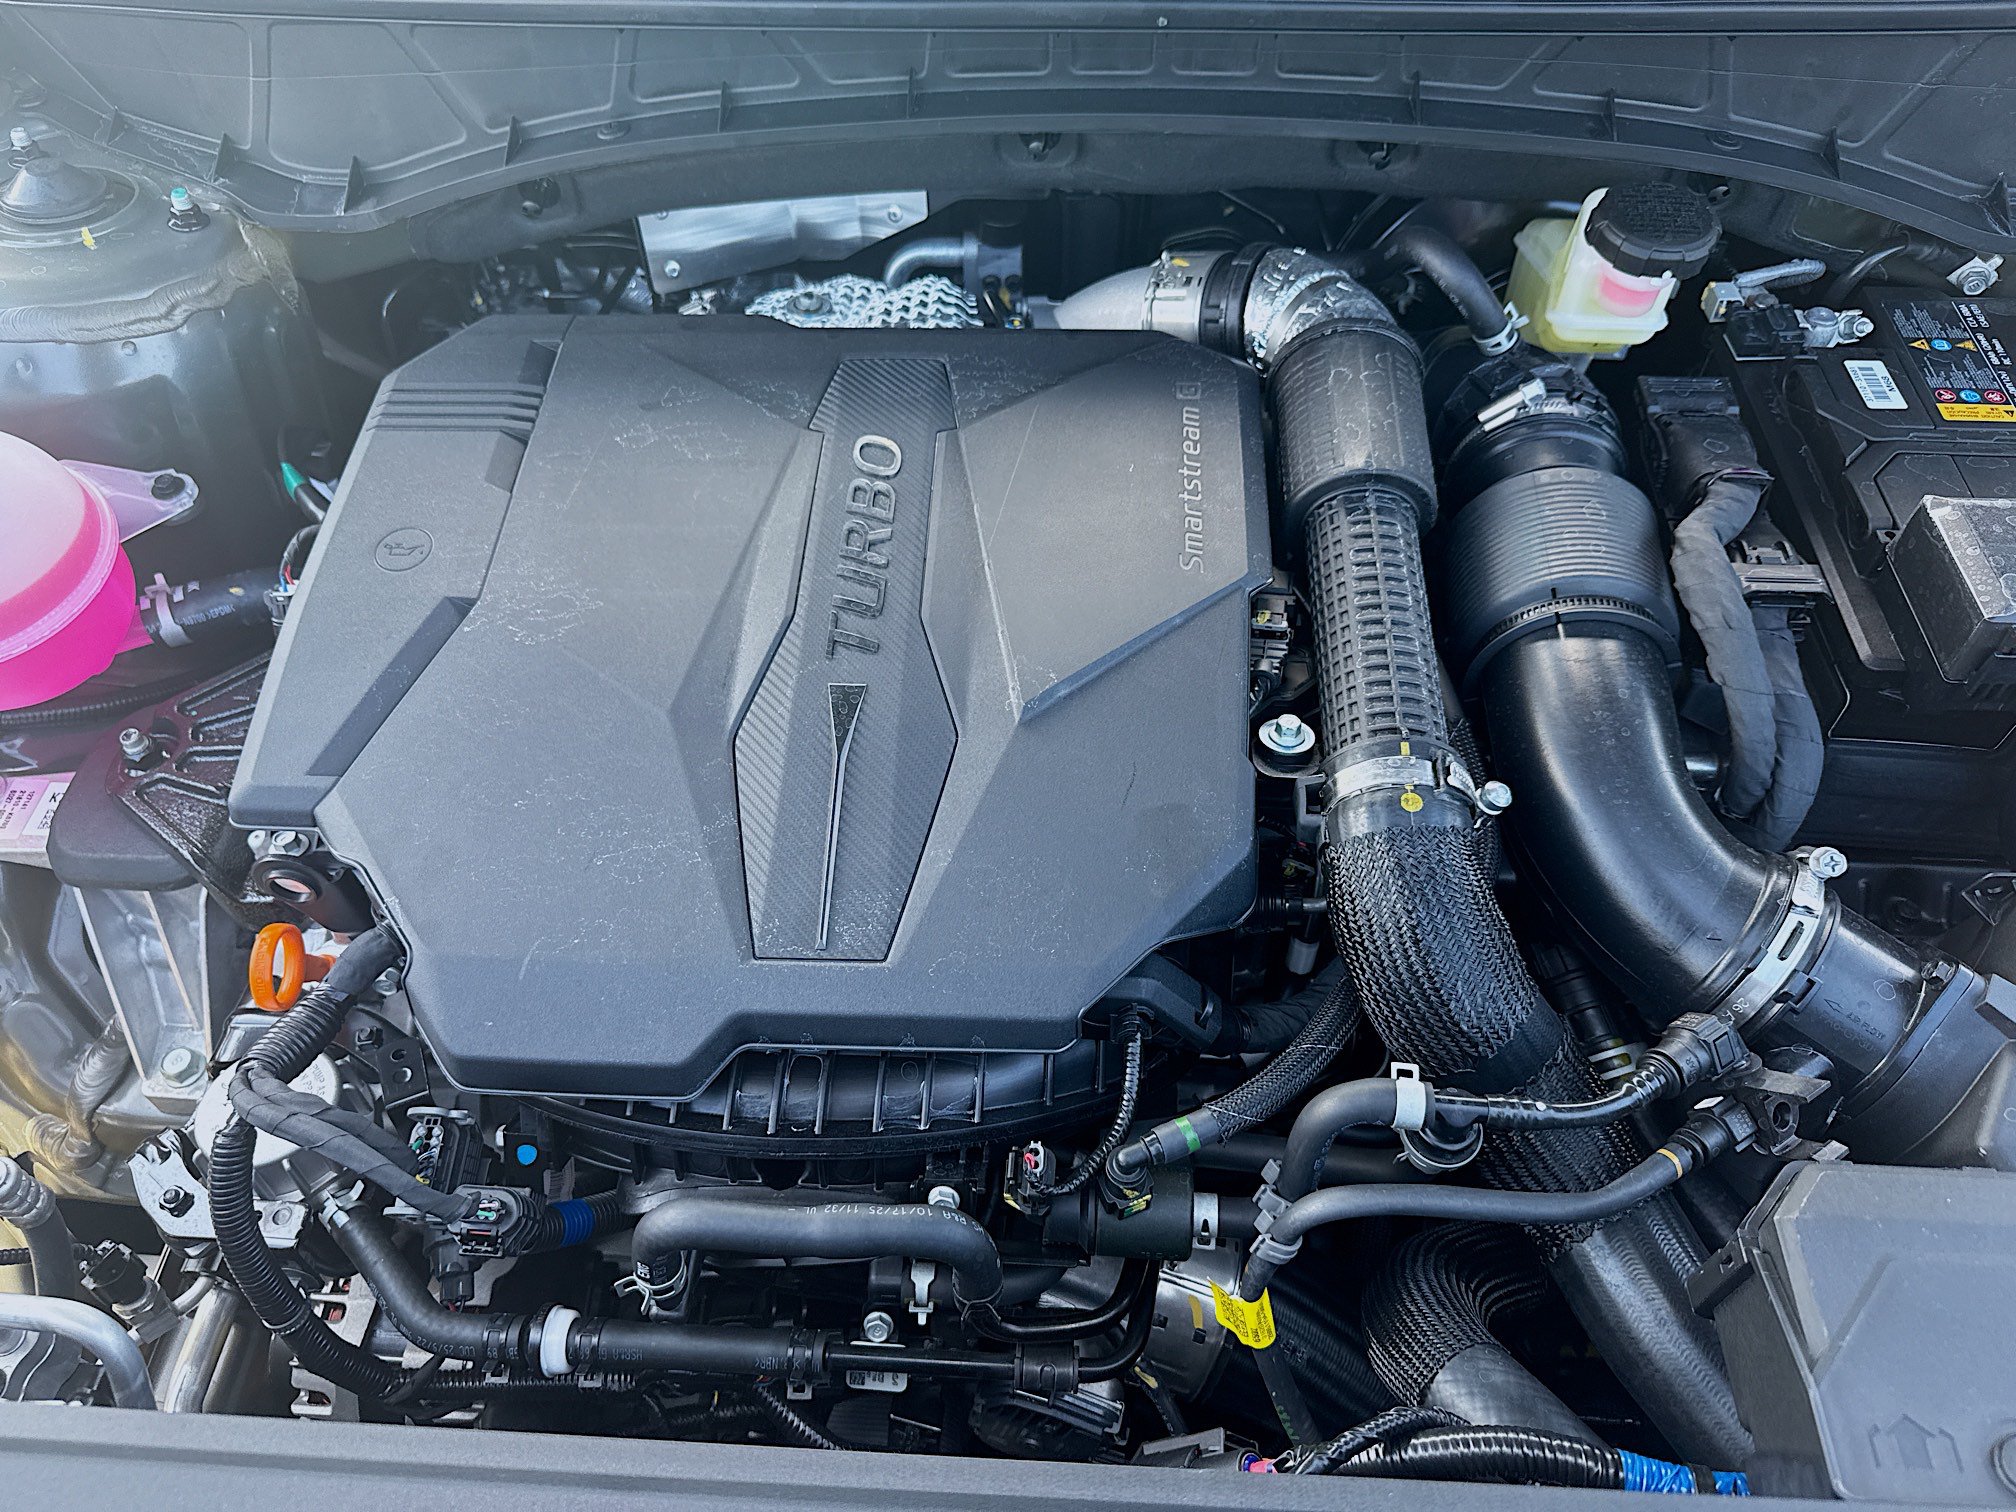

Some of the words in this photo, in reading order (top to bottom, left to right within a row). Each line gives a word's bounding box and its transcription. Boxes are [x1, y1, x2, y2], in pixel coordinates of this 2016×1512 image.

[1880, 375, 1896, 393] M68
[1177, 406, 1204, 573] Smartstream
[825, 433, 904, 661] TURBO
[254, 936, 270, 976] ENGINE
[823, 1203, 860, 1214] 11/32
[868, 1205, 933, 1218] 10/17/25
[942, 1210, 967, 1225] R&A
[636, 1261, 651, 1279] ENG
